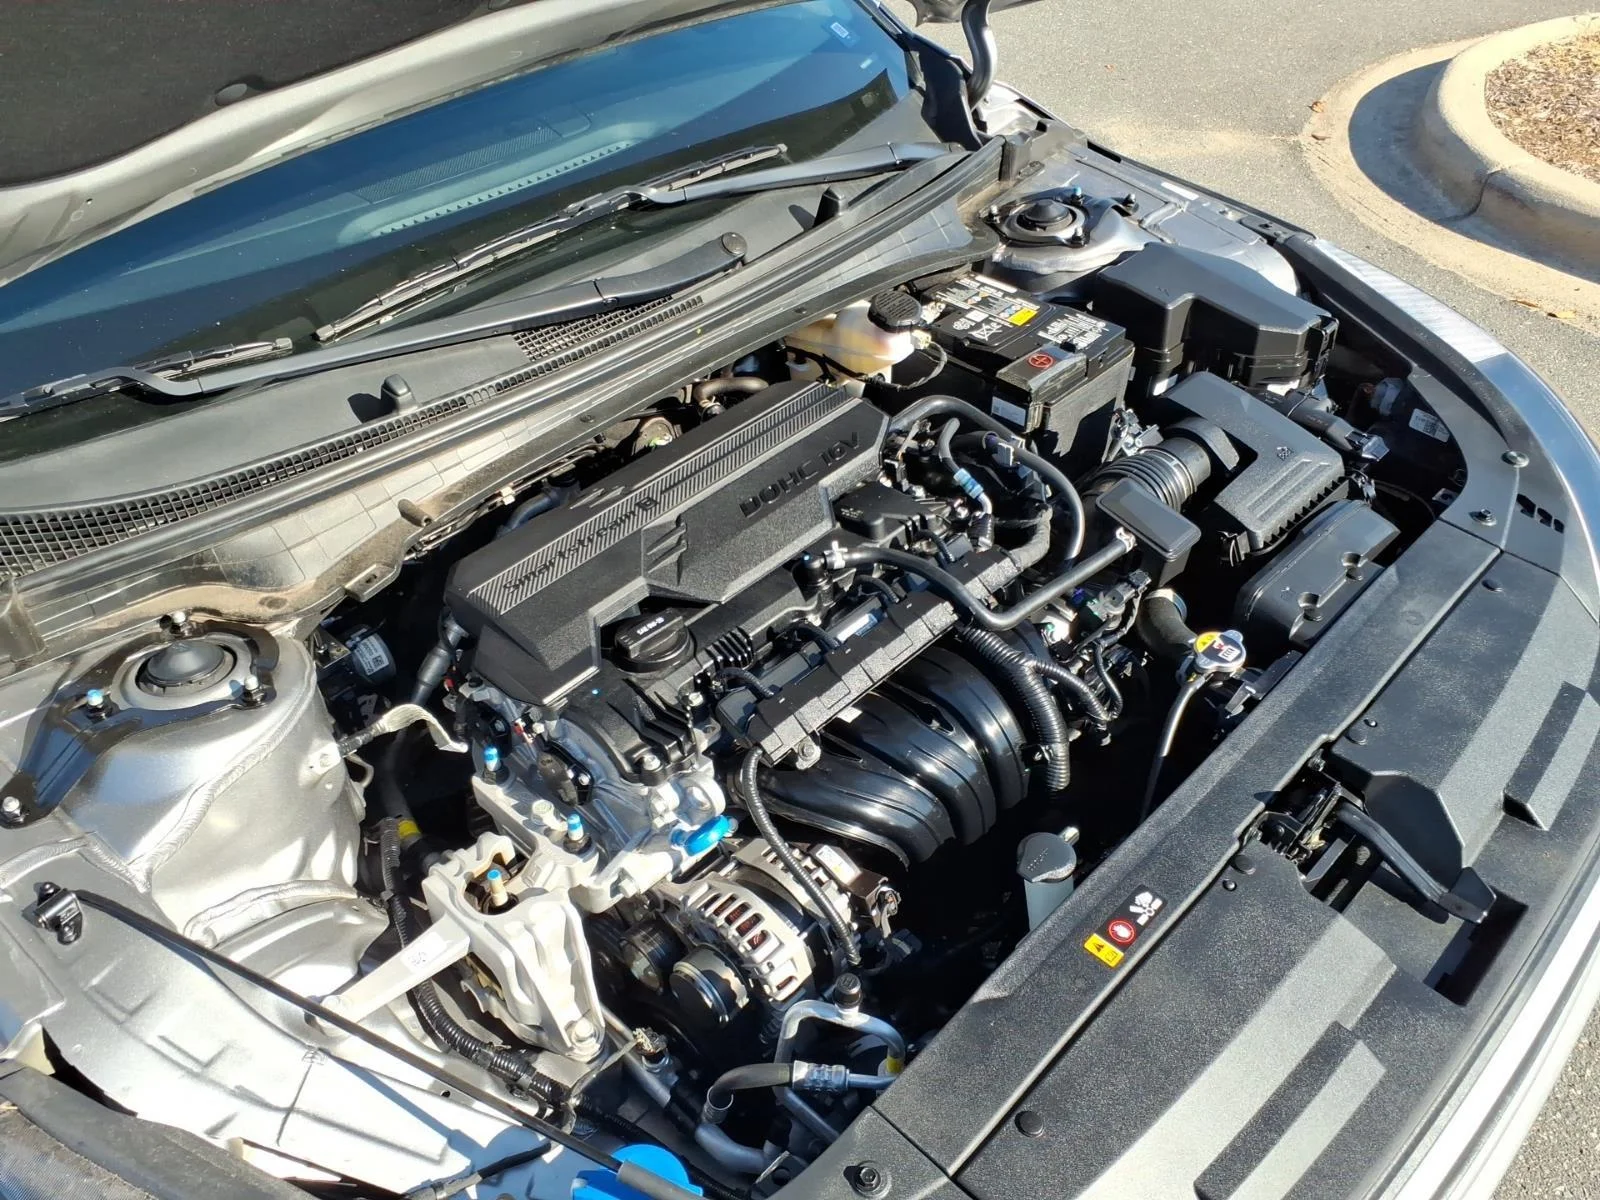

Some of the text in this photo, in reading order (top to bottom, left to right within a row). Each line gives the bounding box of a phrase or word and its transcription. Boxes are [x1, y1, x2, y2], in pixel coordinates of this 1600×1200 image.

[739, 431, 859, 518] DOHC 16V
[502, 509, 637, 594] Smartstream
